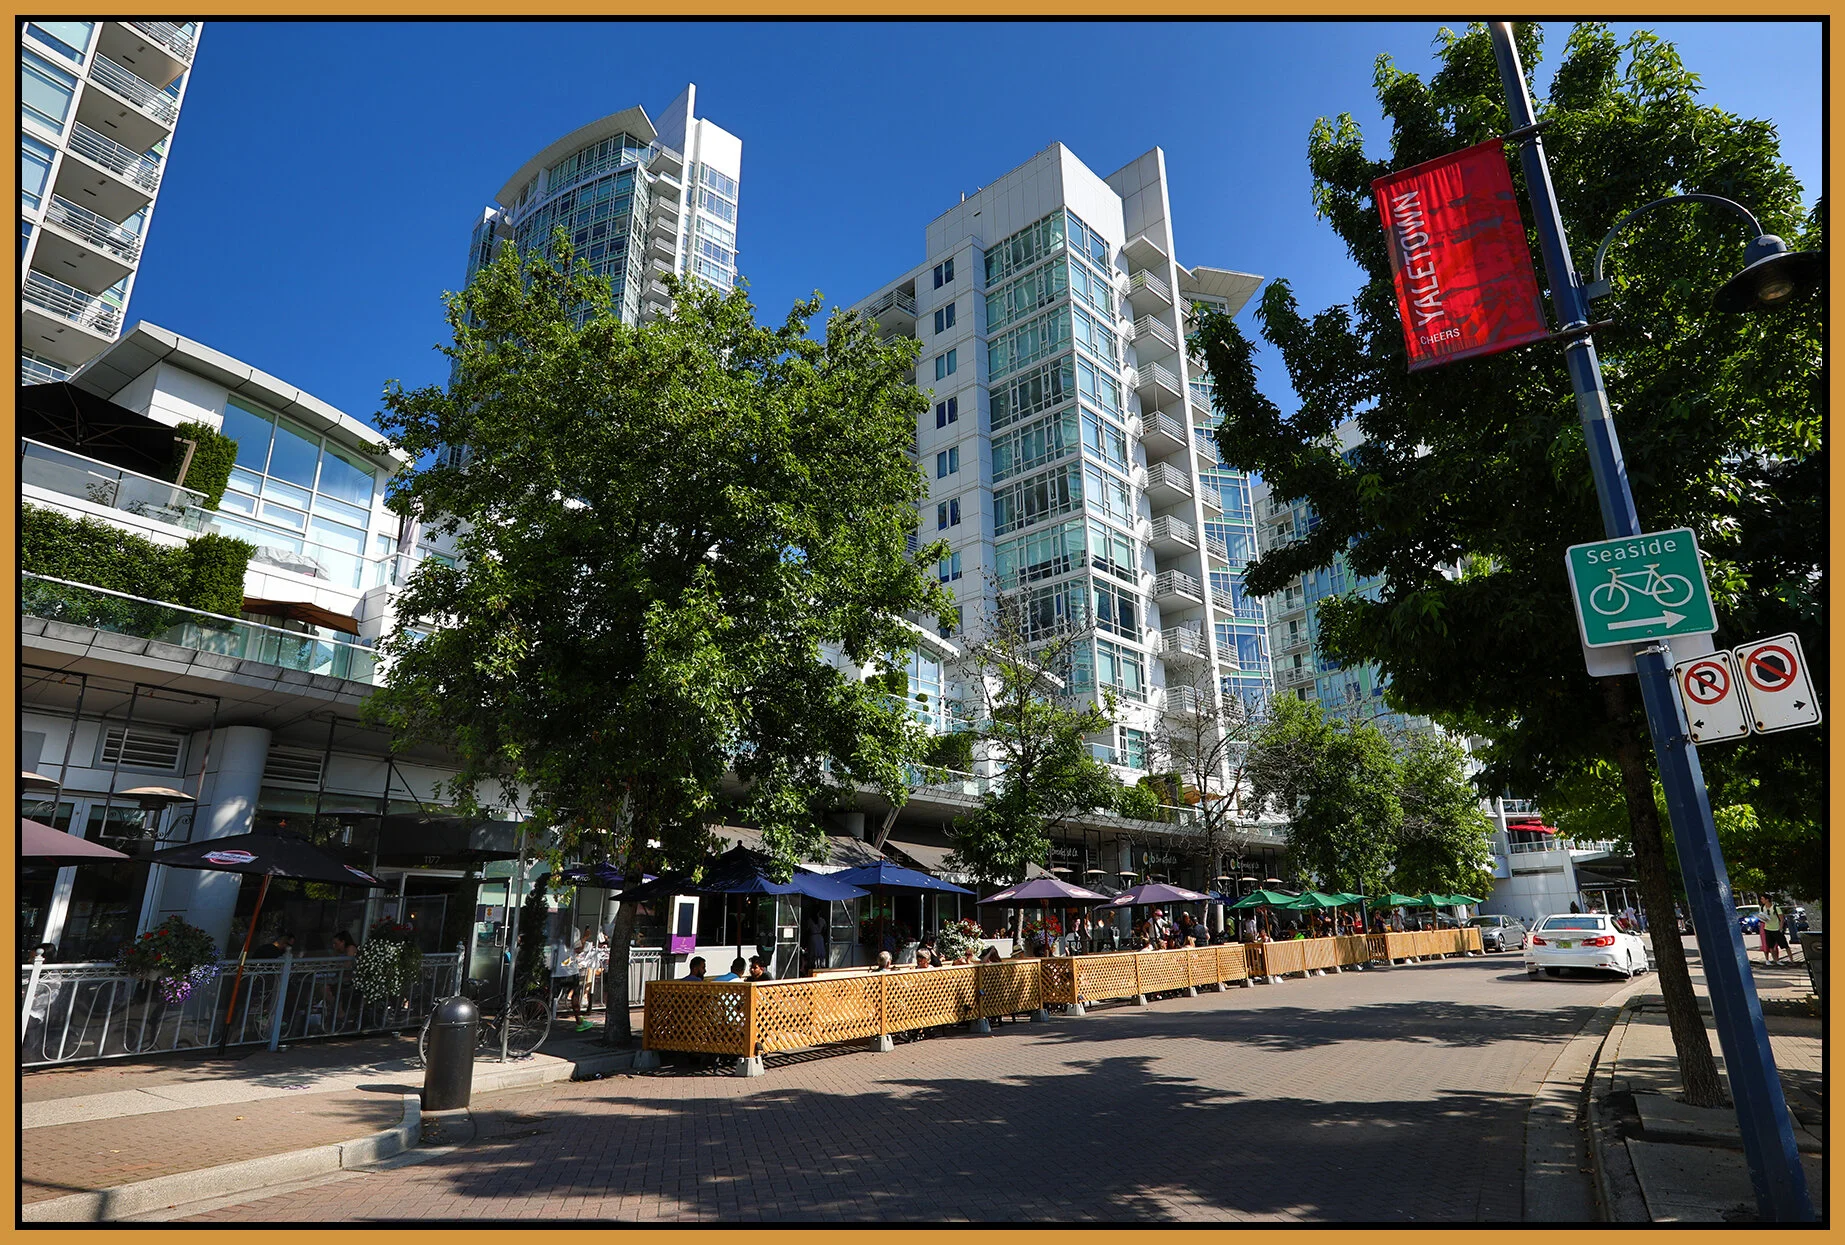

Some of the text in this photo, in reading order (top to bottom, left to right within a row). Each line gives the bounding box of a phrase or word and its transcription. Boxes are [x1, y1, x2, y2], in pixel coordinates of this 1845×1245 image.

[1391, 190, 1445, 326] YALETOWN
[1420, 328, 1460, 345] CHEERS
[1586, 538, 1677, 564] Seaside
